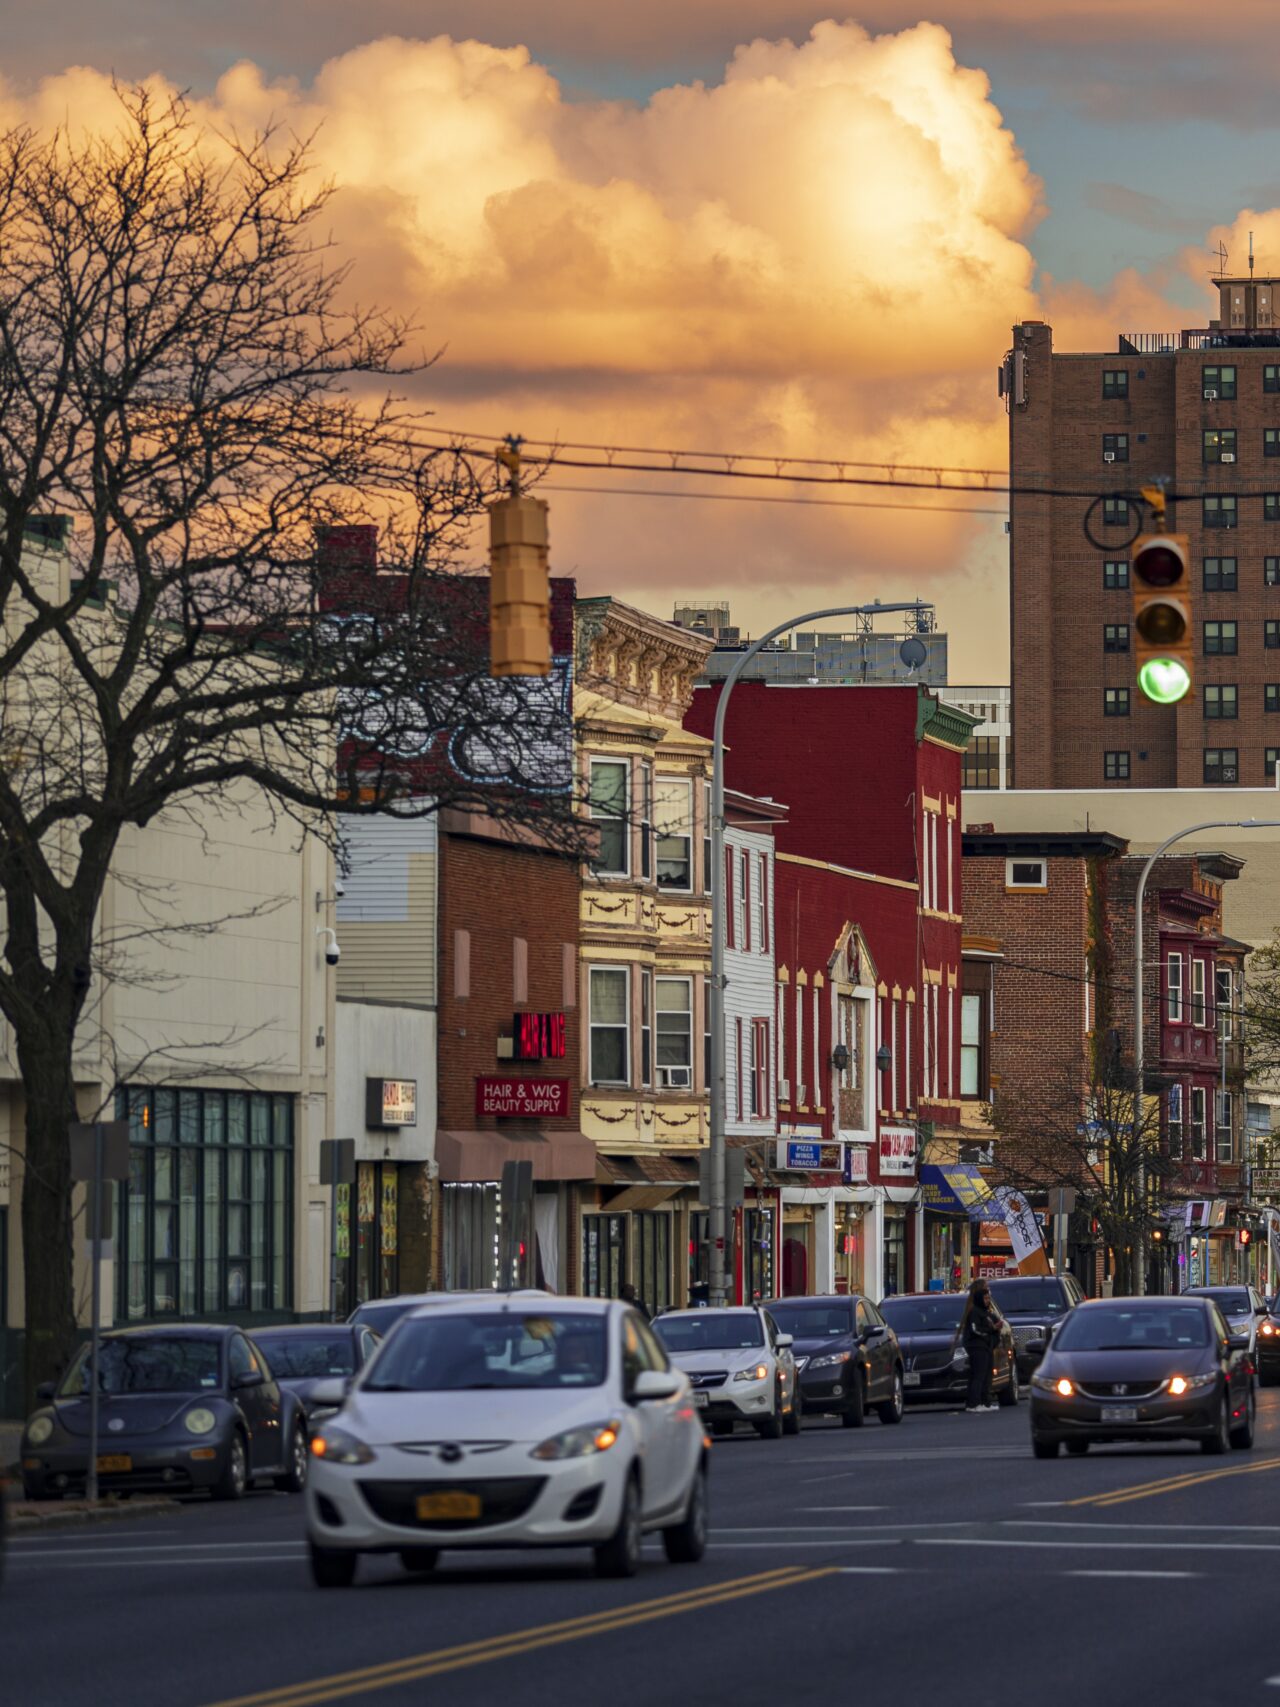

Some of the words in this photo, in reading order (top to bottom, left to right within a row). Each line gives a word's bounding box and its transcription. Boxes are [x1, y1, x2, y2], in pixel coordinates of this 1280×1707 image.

[484, 1084, 512, 1098] HAIR
[516, 1084, 527, 1098] &
[532, 1085, 561, 1099] WIG
[484, 1098, 521, 1112] BEAUTY
[524, 1099, 561, 1113] SUPPLY
[1016, 1213, 1033, 1248] boost
[979, 1268, 1010, 1277] FREE
